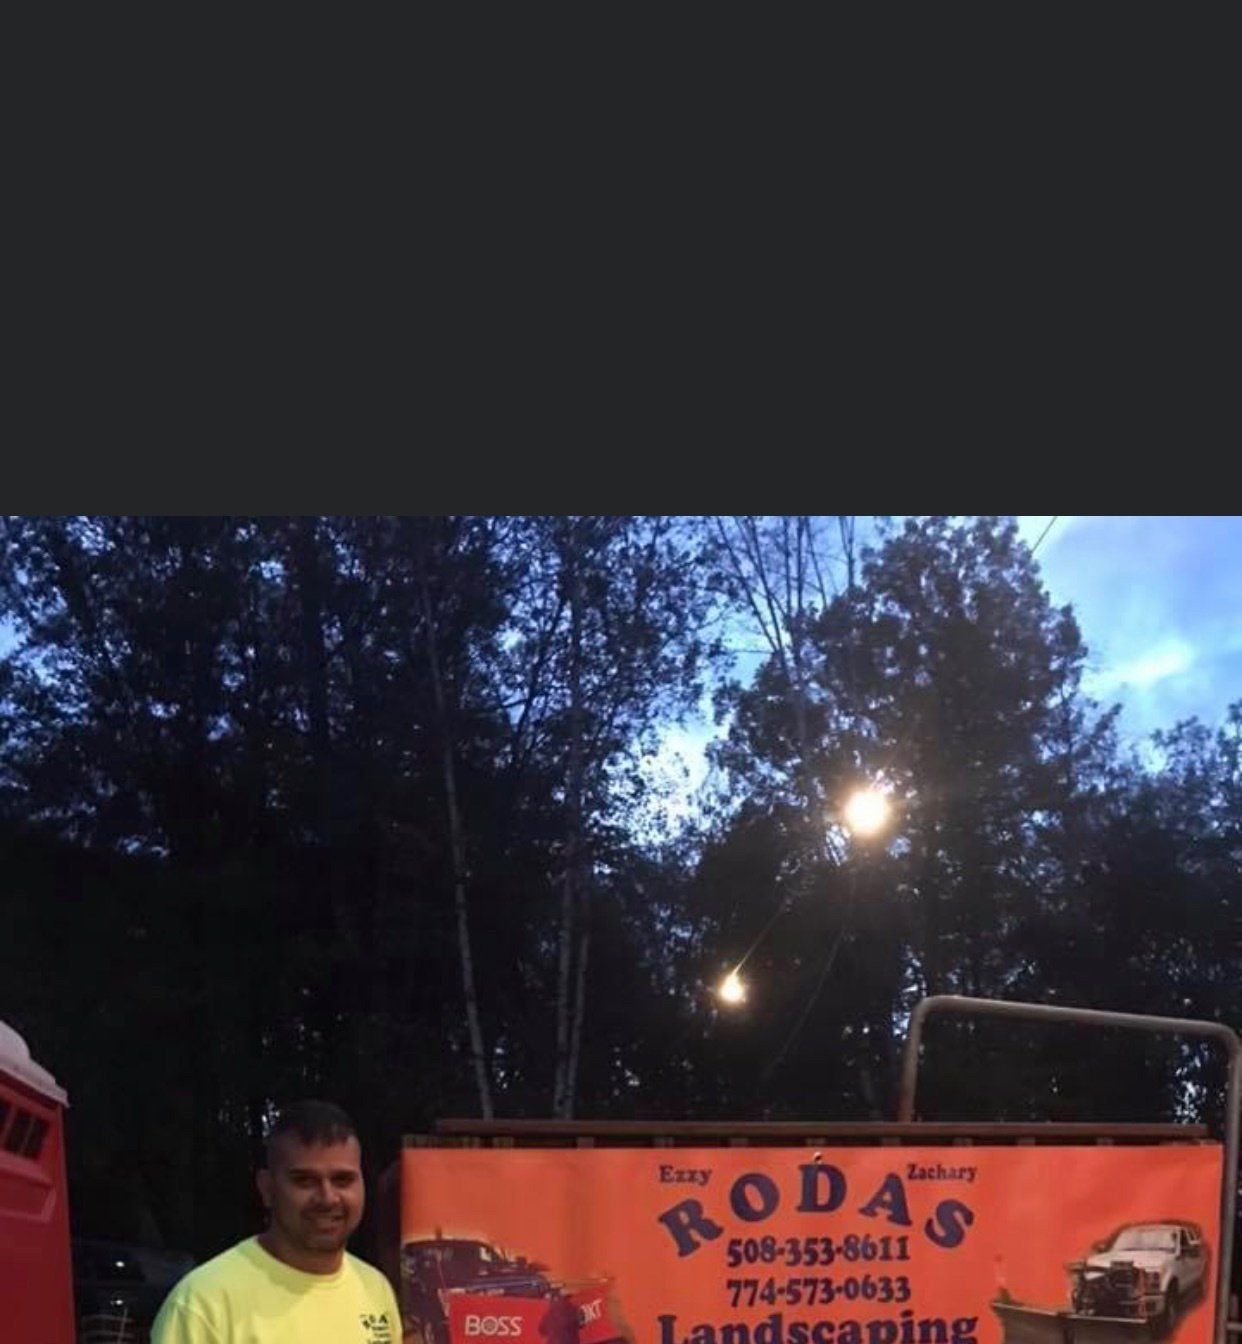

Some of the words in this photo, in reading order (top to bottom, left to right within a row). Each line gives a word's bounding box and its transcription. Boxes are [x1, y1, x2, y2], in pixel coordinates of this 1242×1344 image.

[659, 1165, 712, 1186] Ezzy
[906, 1163, 978, 1184] Zachary
[657, 1163, 975, 1258] RODAS
[727, 1234, 911, 1268] 508-353-8611
[727, 1274, 912, 1308] 774-573-0633
[464, 1314, 523, 1337] BOSS
